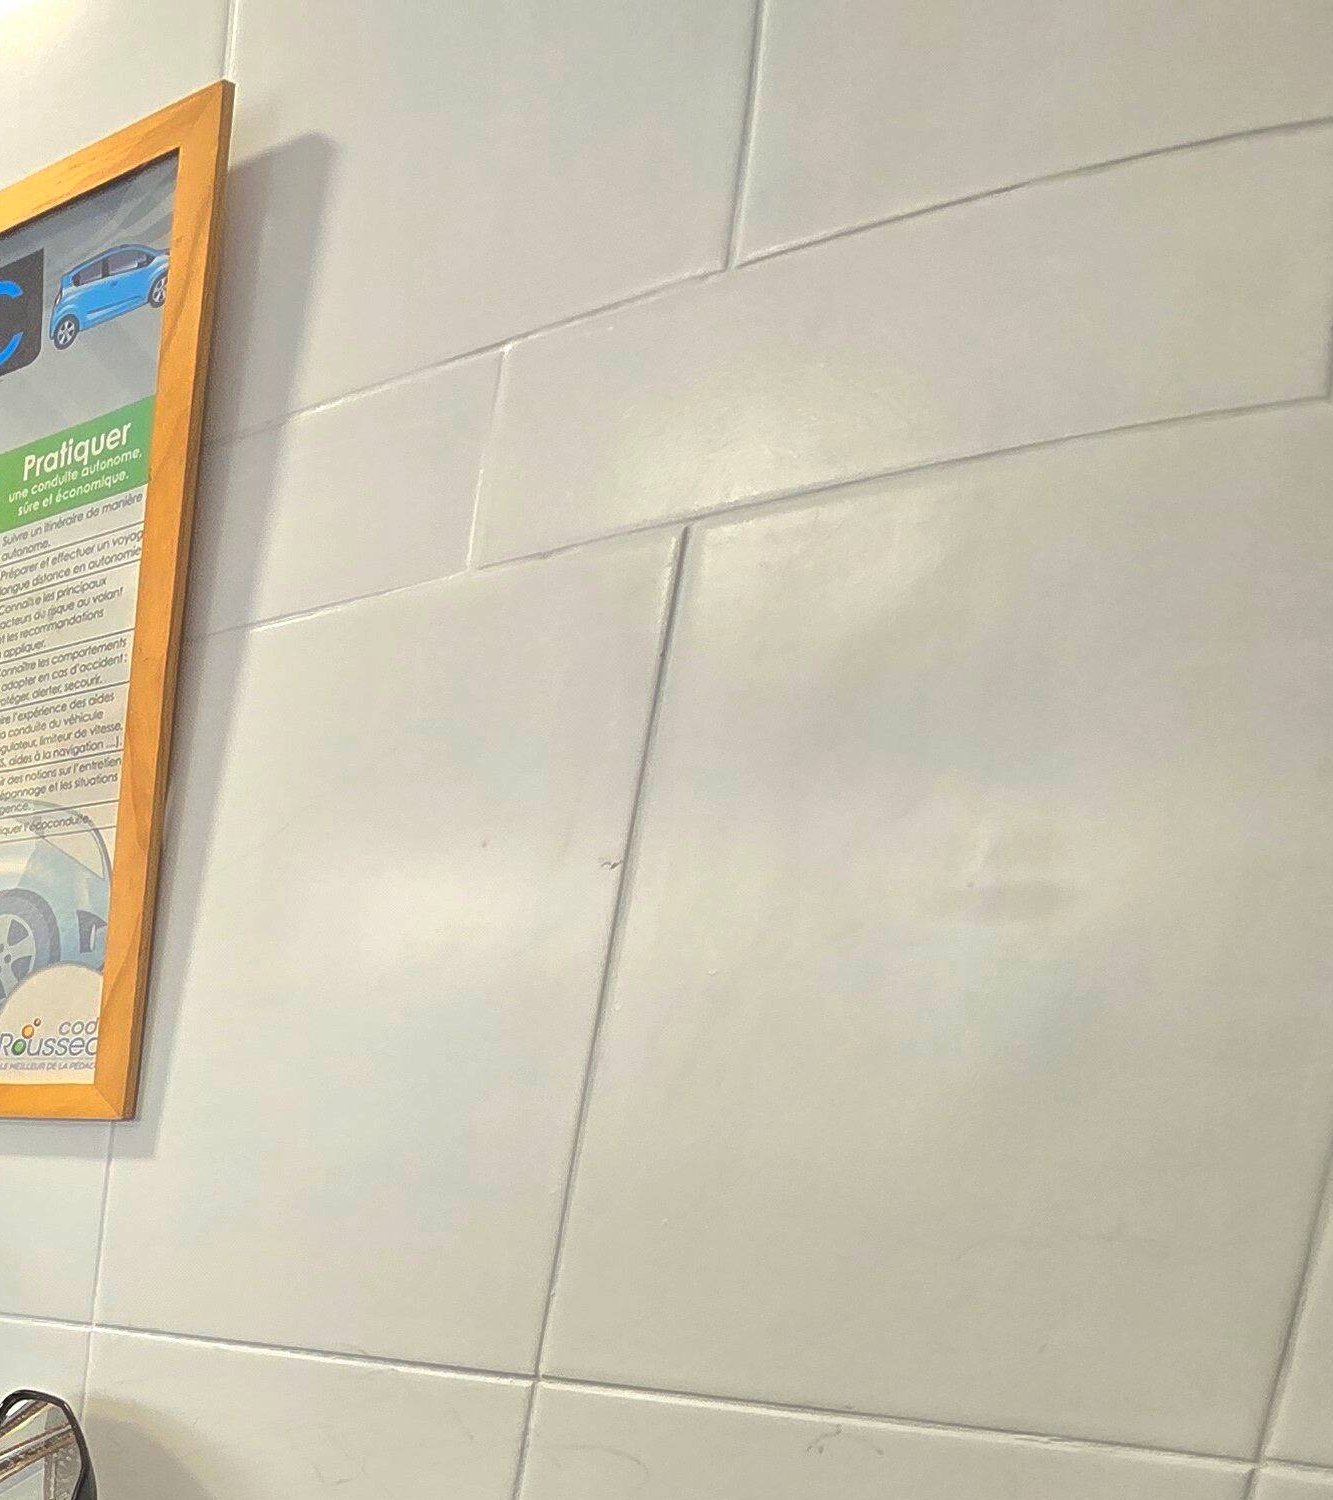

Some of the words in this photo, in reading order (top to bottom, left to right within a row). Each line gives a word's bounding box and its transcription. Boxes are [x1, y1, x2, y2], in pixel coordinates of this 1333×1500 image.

[23, 422, 132, 481] Pratiquer
[9, 486, 28, 503] une
[31, 468, 78, 495] conduite
[81, 448, 142, 478] autonome,
[17, 500, 40, 517] sûre
[42, 493, 53, 509] et
[55, 470, 129, 504] économique.
[2, 530, 29, 547] Suivre
[30, 525, 42, 538] un
[43, 512, 83, 534] itinéraire
[85, 506, 99, 521] de
[101, 493, 144, 515] manière
[0, 561, 38, 582] Préparer
[40, 554, 50, 569] et
[51, 542, 96, 566] effectuer
[97, 538, 111, 551] un
[1, 539, 51, 562] autonome.
[32, 567, 71, 587] distance
[73, 562, 86, 574] en
[88, 545, 141, 570] autonomie
[43, 591, 55, 603] les
[56, 576, 107, 604] principaux
[47, 599, 75, 616] risque
[76, 595, 89, 607] au
[92, 583, 123, 603] volant
[6, 630, 19, 643] les
[19, 608, 105, 639] recommandations
[3, 638, 46, 660] appliquer.
[38, 656, 50, 669] les
[51, 636, 127, 665] comportements
[1, 675, 36, 692] adopter
[38, 671, 50, 683] en
[51, 667, 68, 679] cas
[32, 684, 63, 699] alerter,
[64, 674, 103, 692] secourir.
[12, 702, 67, 723] l'expérience
[69, 697, 87, 710] des
[88, 692, 115, 706] aides
[7, 720, 47, 738] conduite
[48, 717, 62, 730] du
[63, 708, 104, 727] véhicule
[39, 732, 72, 746] limiteur
[74, 727, 87, 739] de
[8, 752, 33, 765] aides
[34, 749, 41, 761] à
[42, 748, 52, 759] la
[53, 740, 104, 758] navigation
[7, 772, 23, 785] des
[25, 767, 57, 782] notions
[58, 765, 72, 775] sur
[73, 756, 122, 773] l'entretien
[48, 780, 58, 792] et
[60, 778, 73, 790] les
[74, 772, 118, 788] situations
[59, 1018, 98, 1035] cod
[10, 1062, 45, 1070] MEILLEUR
[47, 1061, 57, 1070] DE
[58, 1061, 68, 1069] LA
